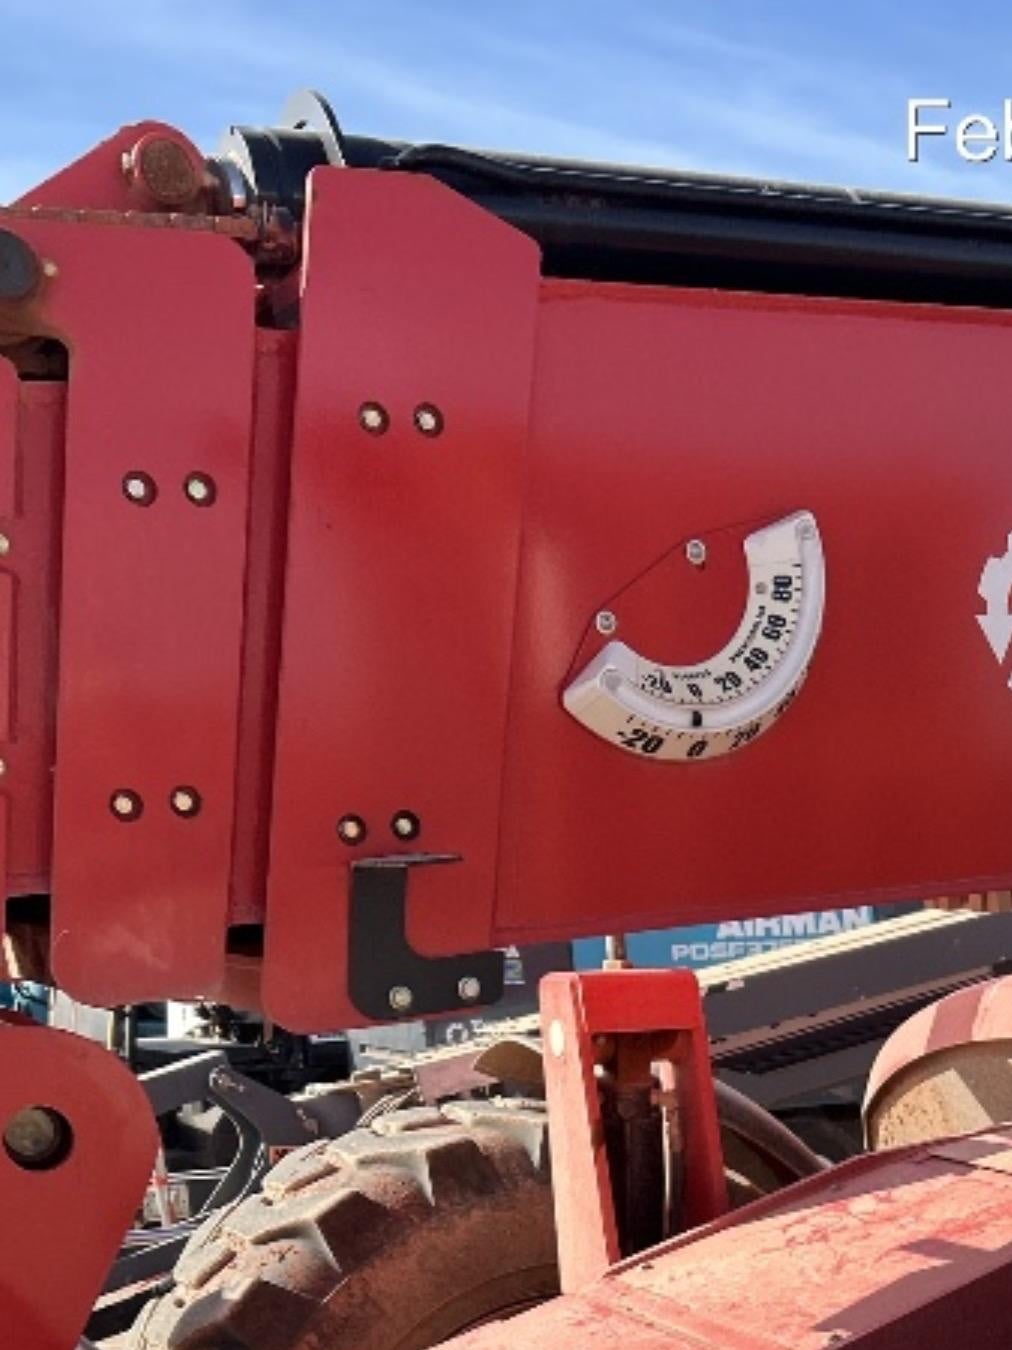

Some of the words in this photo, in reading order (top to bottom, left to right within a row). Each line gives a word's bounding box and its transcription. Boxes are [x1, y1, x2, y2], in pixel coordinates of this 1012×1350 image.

[770, 574, 793, 602] 80
[761, 614, 787, 641] 60
[713, 671, 742, 694] 20
[616, 728, 664, 753] -20
[686, 740, 709, 758] 0
[716, 905, 874, 940] AIRMAN
